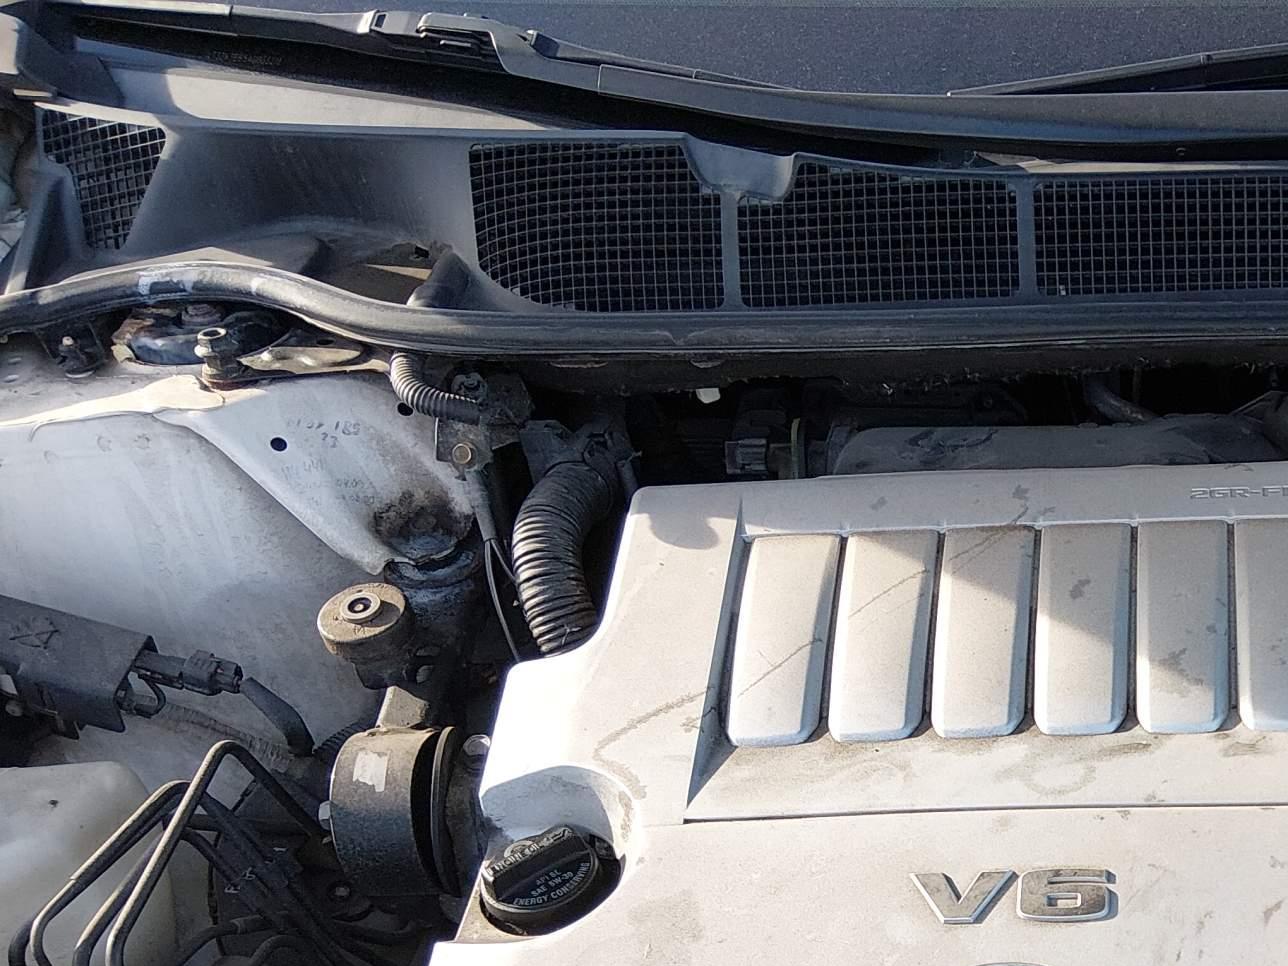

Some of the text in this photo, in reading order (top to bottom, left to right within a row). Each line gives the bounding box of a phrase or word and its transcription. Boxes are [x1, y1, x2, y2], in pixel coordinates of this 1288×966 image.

[512, 862, 591, 906] ENERGY CONSERVING
[531, 886, 548, 897] SAE
[909, 869, 1116, 924] V6
